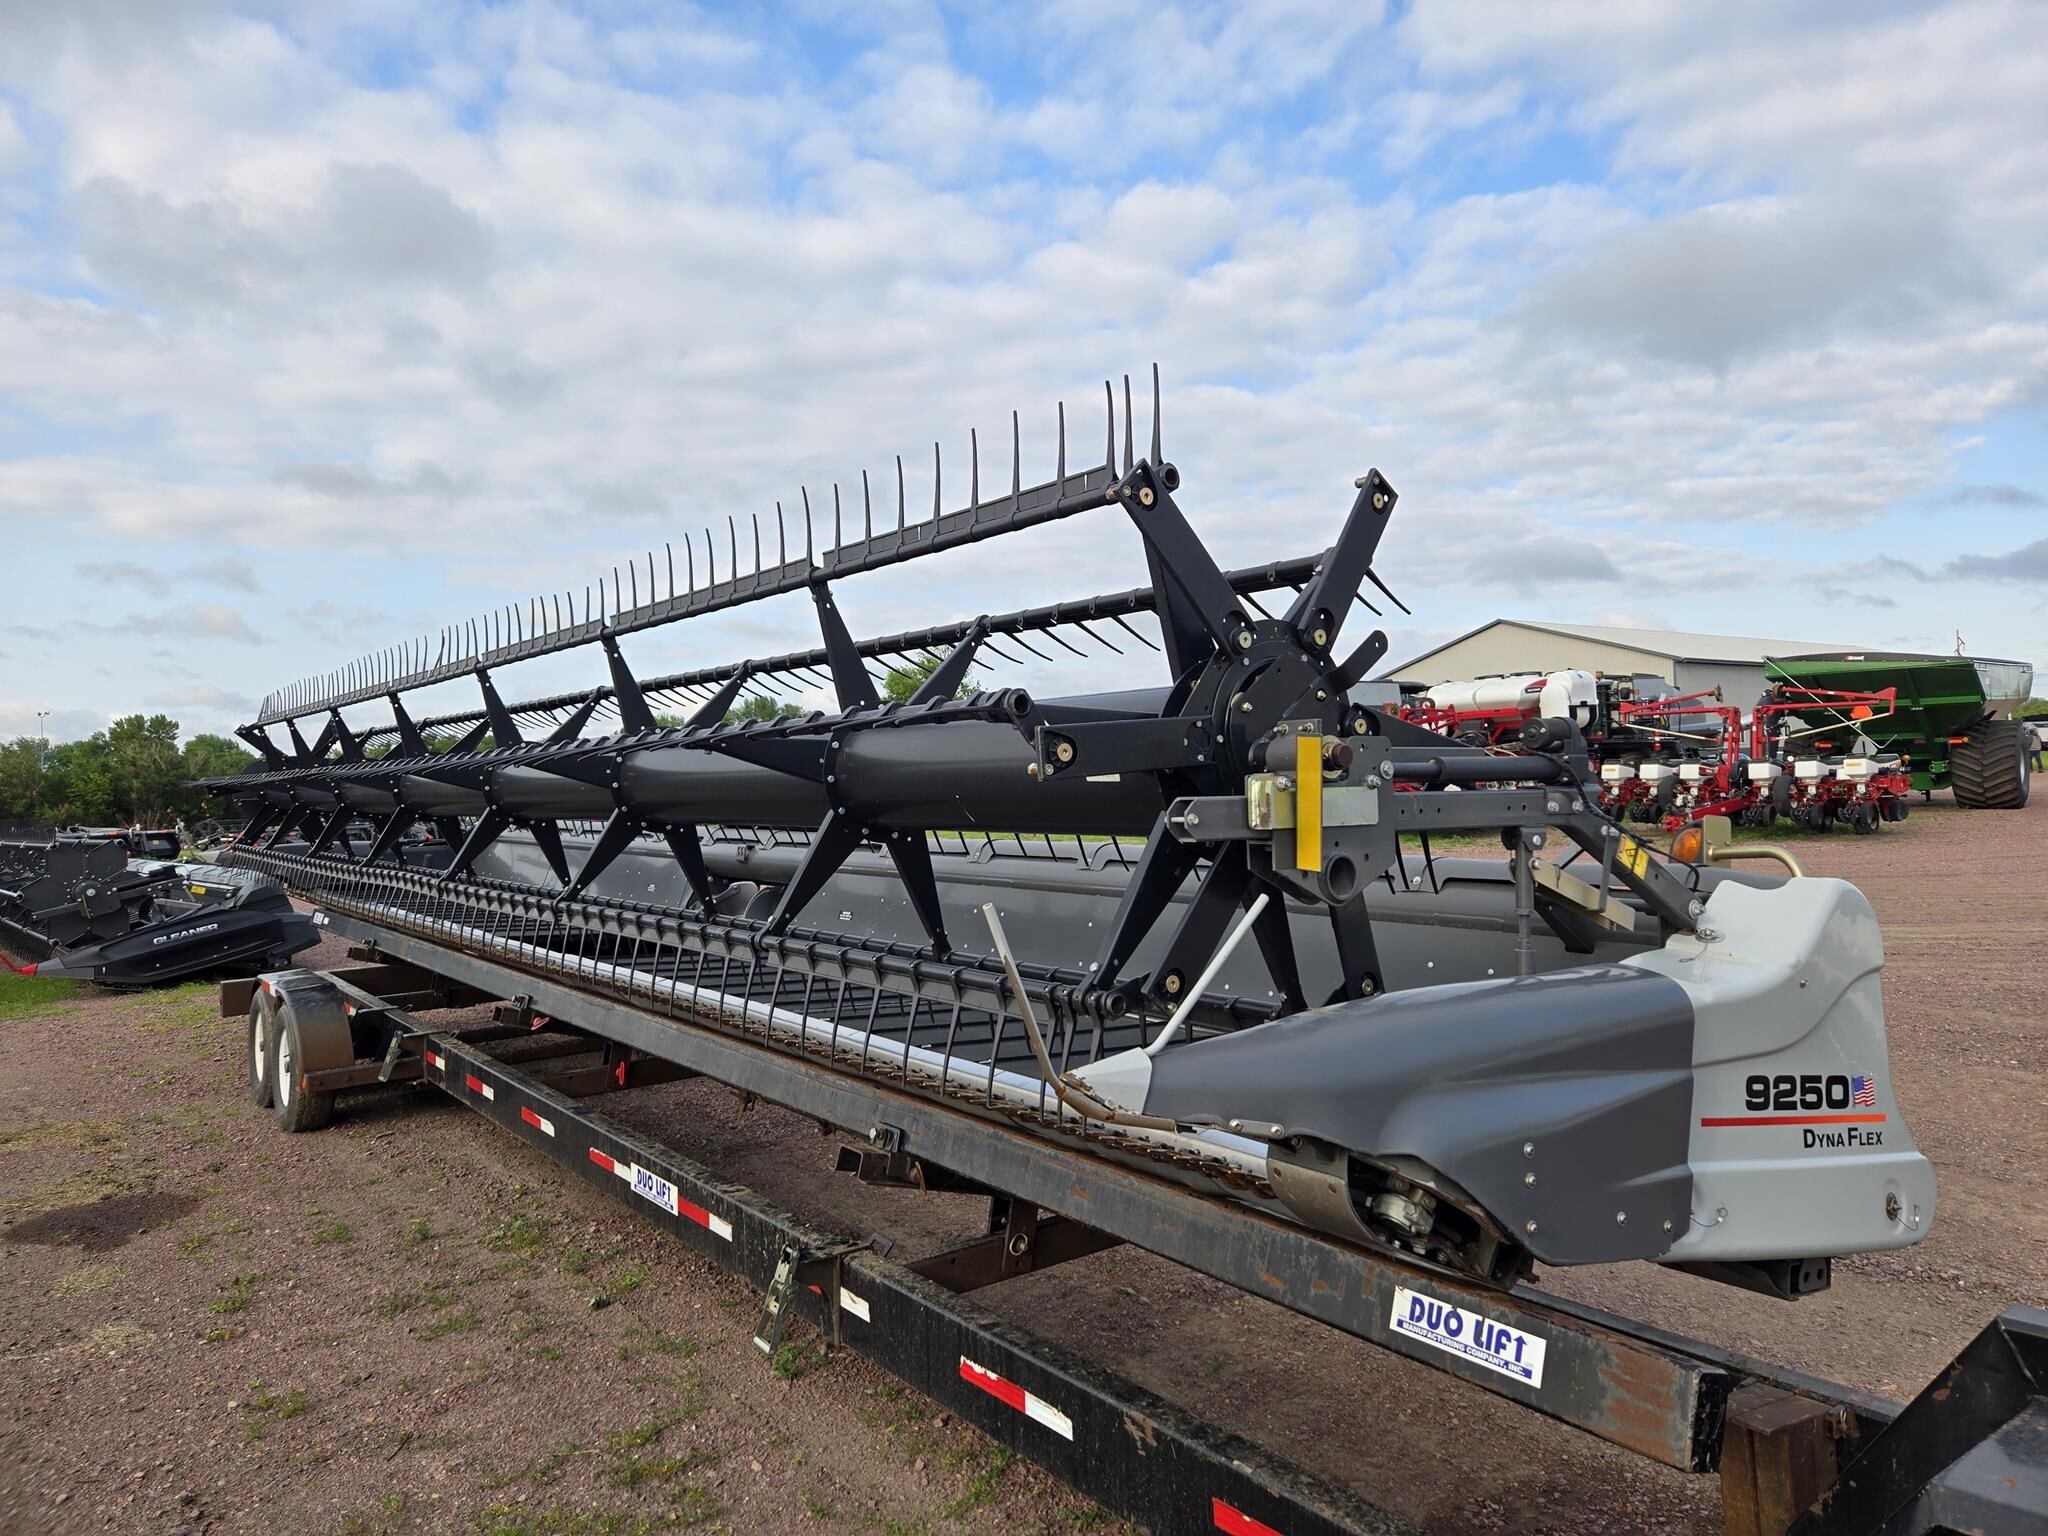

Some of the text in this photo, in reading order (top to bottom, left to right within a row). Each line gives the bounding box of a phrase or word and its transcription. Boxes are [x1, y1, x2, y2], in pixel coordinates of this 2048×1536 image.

[153, 923, 218, 945] GLEANER
[1745, 1074, 1850, 1111] 9250
[637, 1168, 653, 1191] DUO
[1409, 1296, 1528, 1363] DUO LIFT
[1402, 1321, 1465, 1352] MANUFACTURING
[1508, 1362, 1526, 1376] INC.
